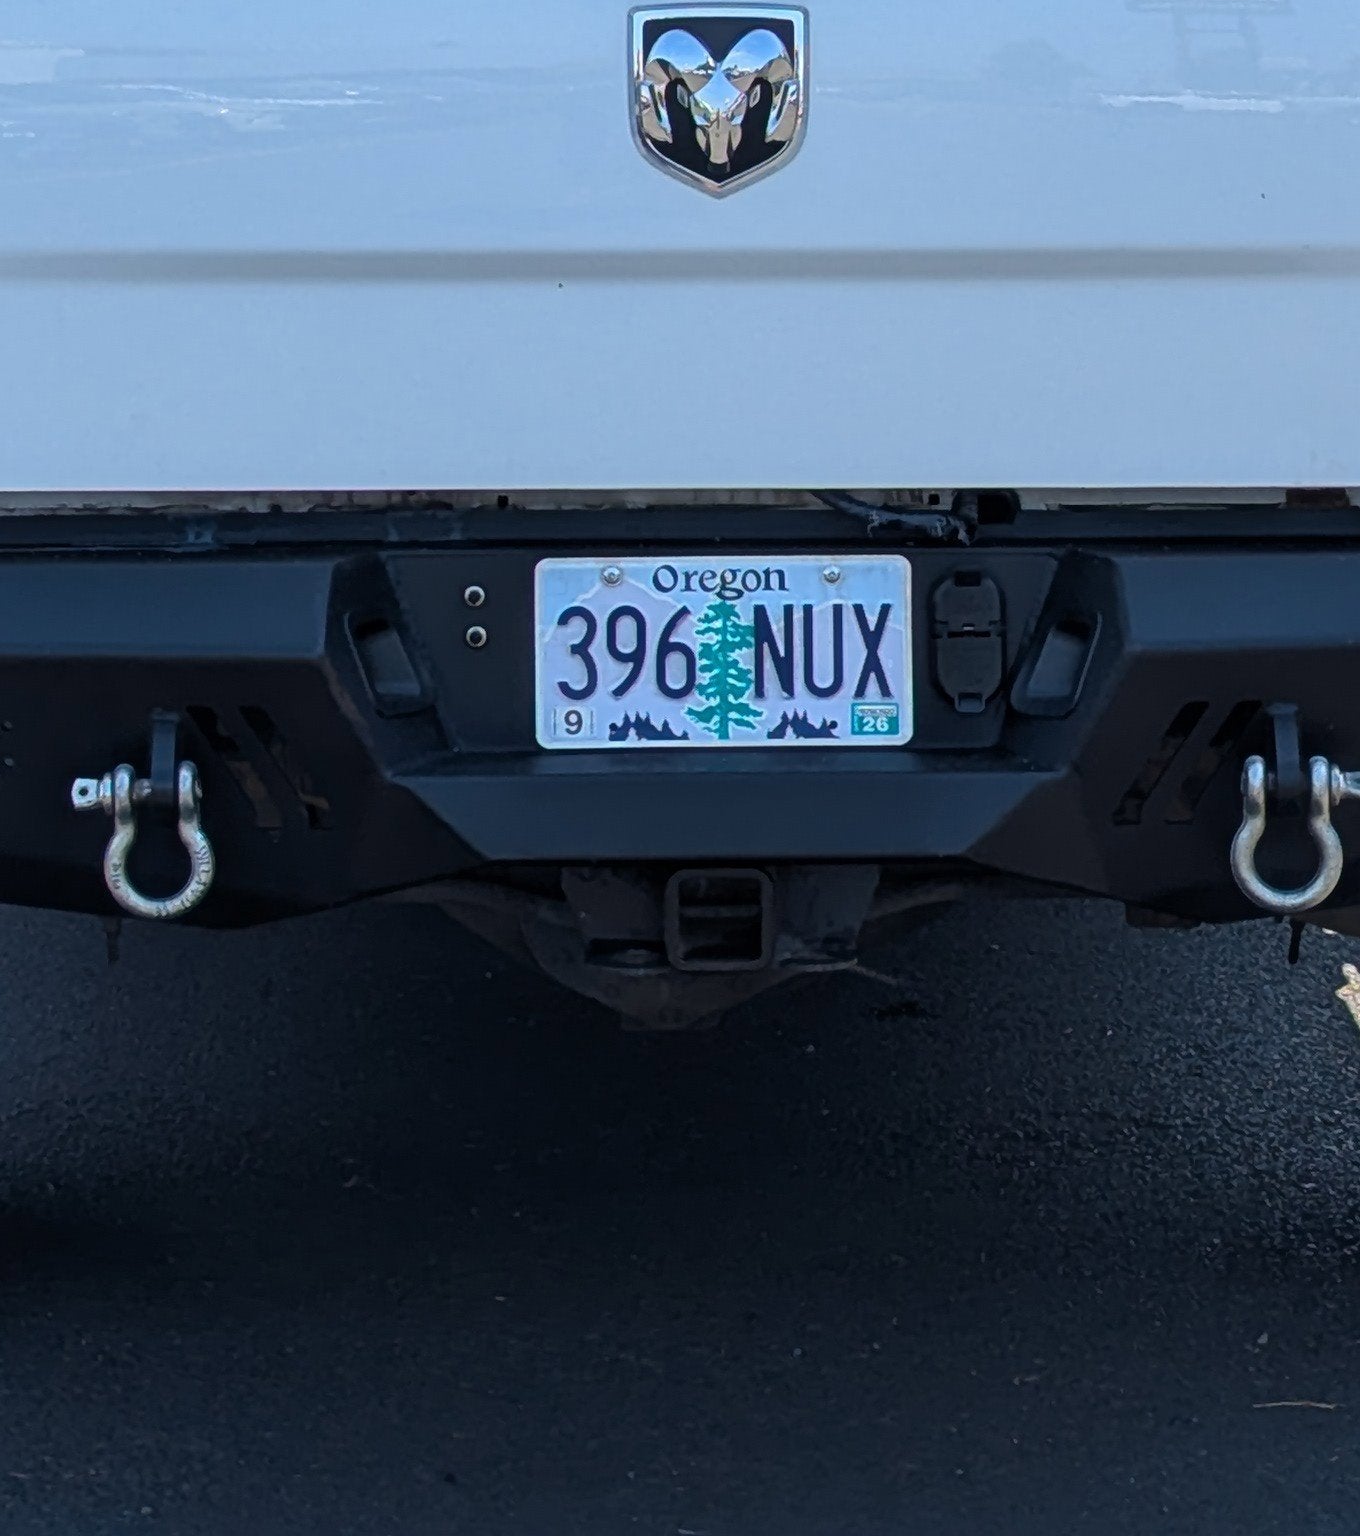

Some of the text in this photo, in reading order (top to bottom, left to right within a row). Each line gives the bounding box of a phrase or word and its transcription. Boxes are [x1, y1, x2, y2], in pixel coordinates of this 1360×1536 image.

[651, 563, 789, 601] Oregon
[556, 602, 894, 701] 396 NUX
[564, 709, 584, 735] 9
[862, 716, 890, 733] 26
